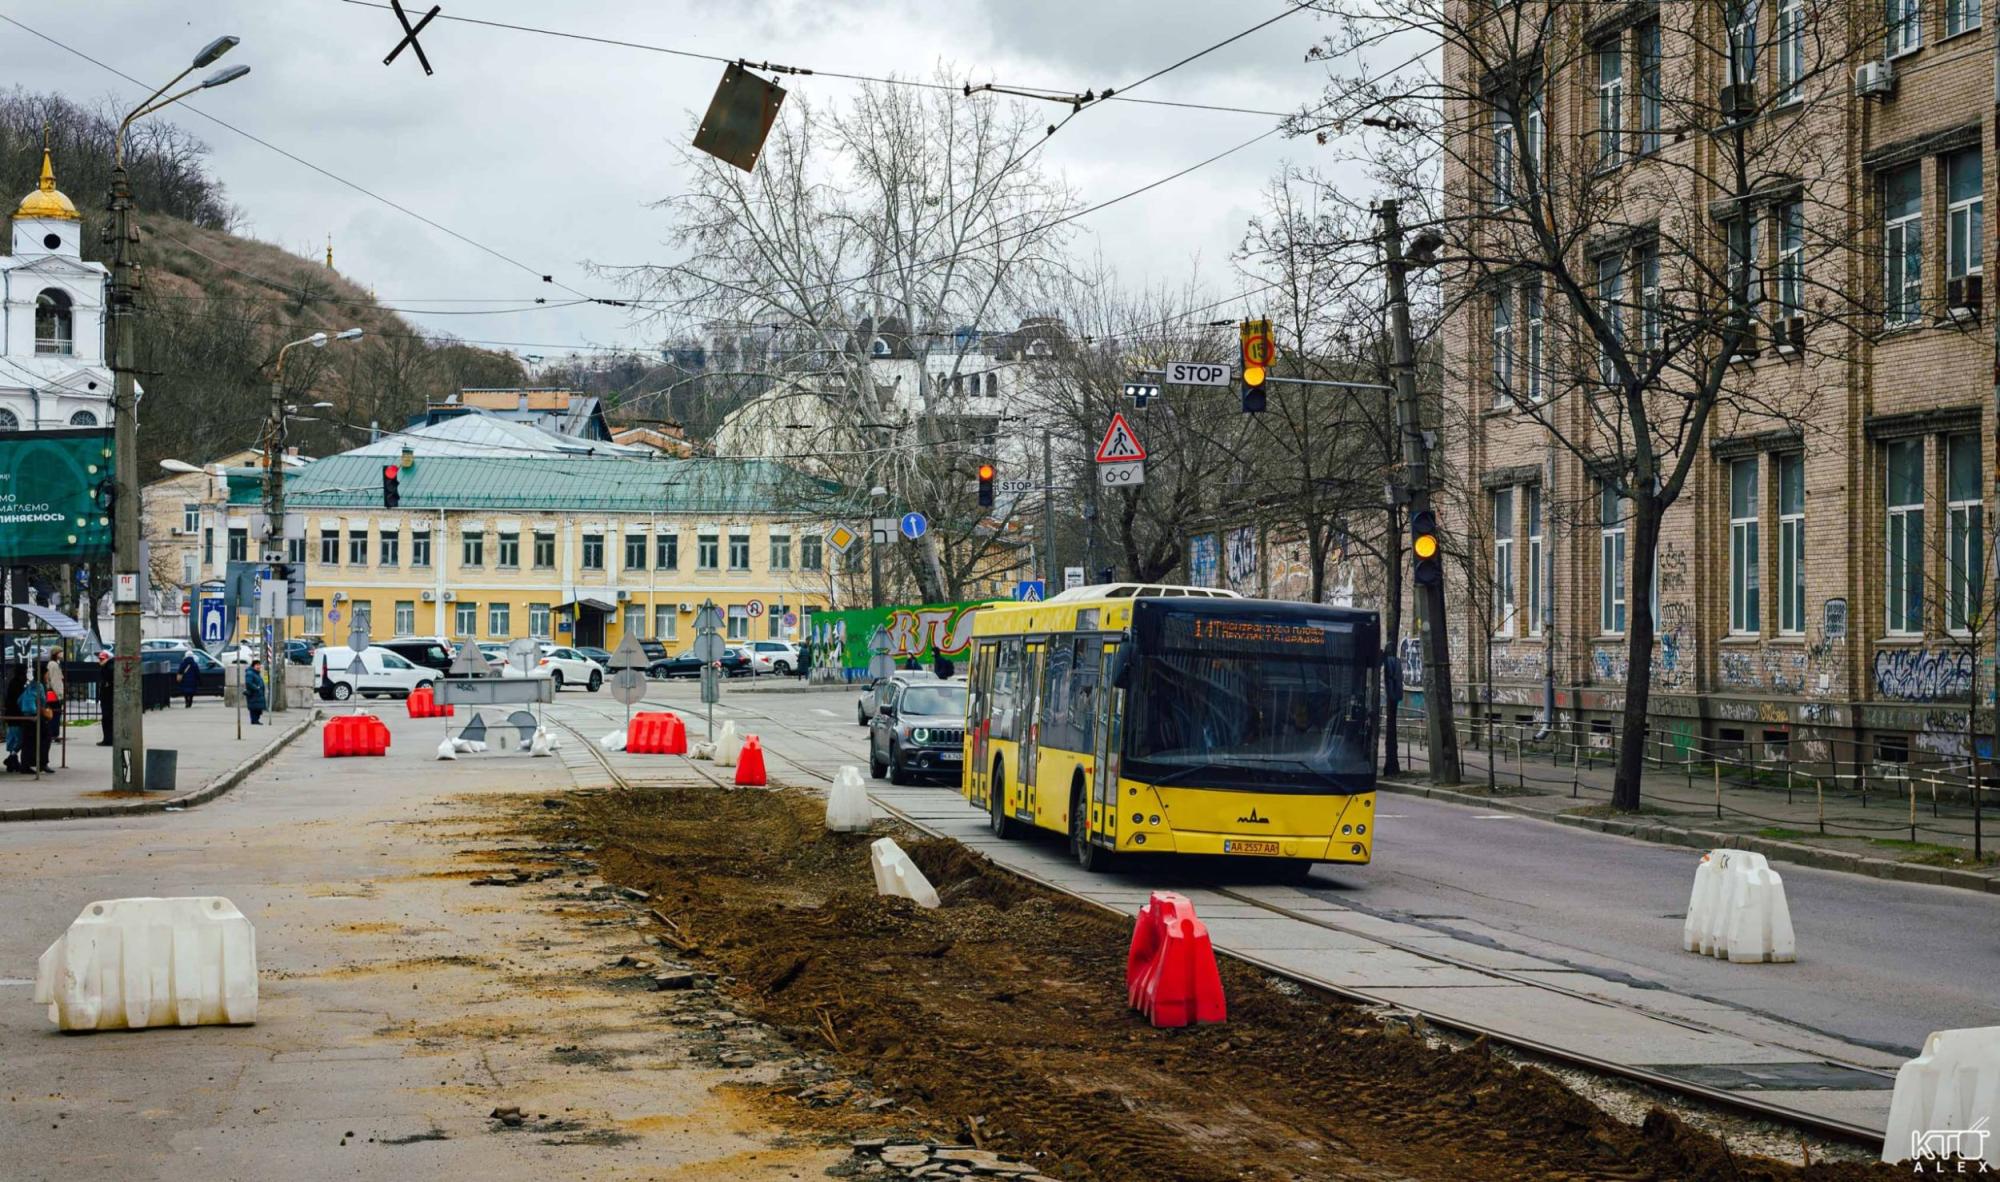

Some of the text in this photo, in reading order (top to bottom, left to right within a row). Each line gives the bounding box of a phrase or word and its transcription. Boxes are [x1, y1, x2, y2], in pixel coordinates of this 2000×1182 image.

[1173, 365, 1223, 382] STOP
[1002, 481, 1032, 490] STOP
[1232, 842, 1276, 853] AA 2557 AA
